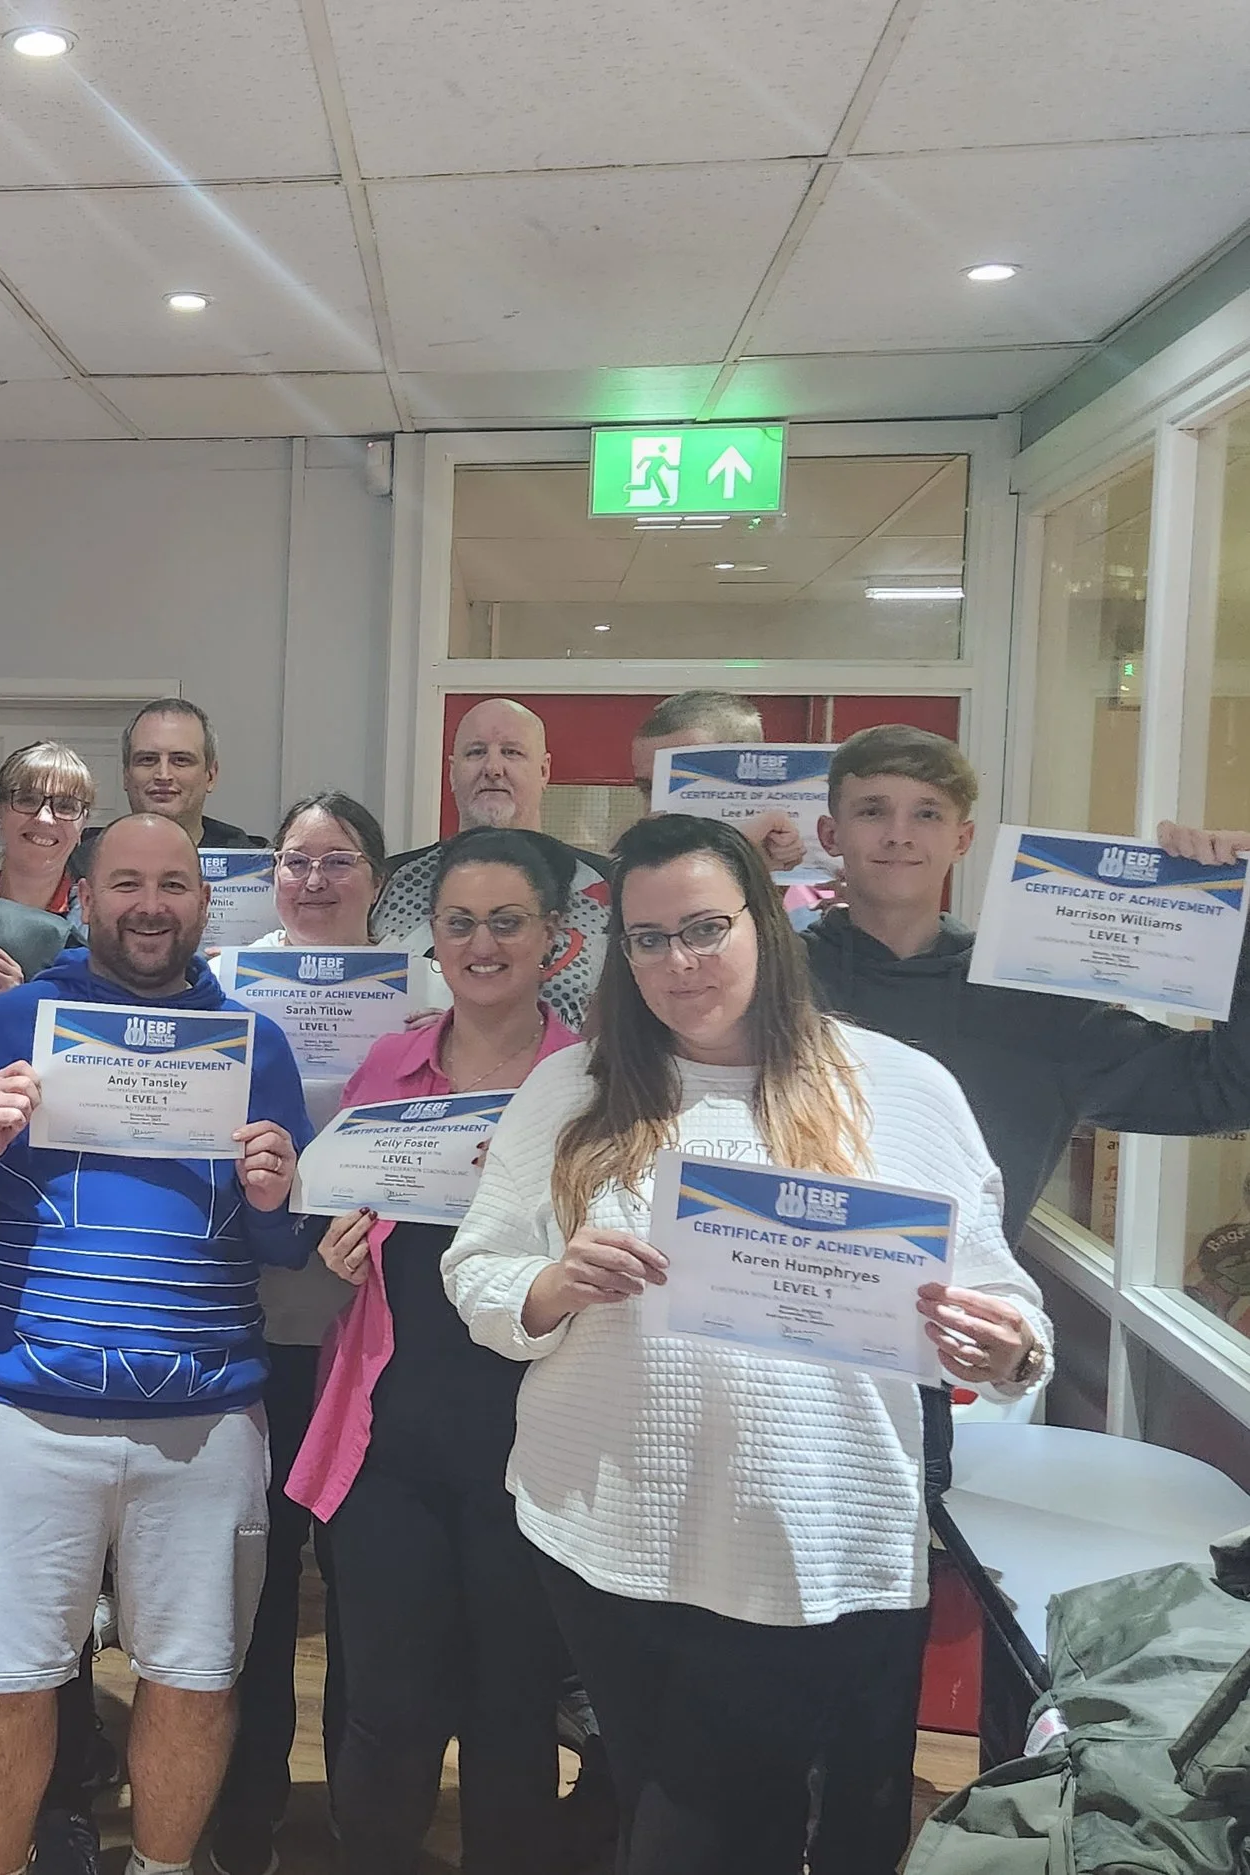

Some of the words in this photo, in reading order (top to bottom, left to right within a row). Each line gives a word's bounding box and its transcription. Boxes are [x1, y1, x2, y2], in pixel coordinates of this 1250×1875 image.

[760, 755, 789, 767] EBF
[680, 791, 747, 800] CERTIFICATE
[751, 792, 763, 800] OF
[766, 792, 828, 801] ACHIEVEME
[721, 808, 741, 818] Lee
[205, 857, 227, 867] EBF
[1125, 851, 1162, 868] EBF
[212, 885, 270, 893] ACHIEVEMENT
[1025, 882, 1105, 902] CERTIFICATE
[1109, 891, 1125, 902] OF
[1128, 894, 1225, 917] ACHIEVEMENT
[1055, 905, 1116, 923] Harrison
[1120, 914, 1183, 932] Williams
[1088, 929, 1129, 945] LEVEL
[1133, 935, 1141, 945] 1
[318, 957, 345, 968] EBF
[246, 989, 307, 998] CERTIFICATE
[310, 990, 323, 998] OF
[325, 990, 396, 1000] ACHIEVEMENT
[285, 1005, 317, 1015] Sarah
[147, 1020, 177, 1034] EBF
[299, 1022, 330, 1031] LEVEL
[332, 1023, 338, 1032] 1
[65, 1054, 135, 1068] CERTIFICATE
[137, 1058, 151, 1068] OF
[154, 1060, 233, 1071] ACHIEVEMENT
[107, 1075, 138, 1088] Andy
[141, 1077, 188, 1090] Tansley
[125, 1094, 158, 1104] LEVEL
[162, 1096, 168, 1104] 1
[341, 1127, 400, 1136] CERTIFICATE
[402, 1125, 418, 1133] OF
[419, 1124, 489, 1133] ACHIEVEMENT
[374, 1139, 401, 1149] Kelly
[403, 1139, 440, 1149] Foster
[382, 1155, 413, 1165] LEVEL
[417, 1156, 423, 1165] 1
[807, 1187, 850, 1207] EBF
[693, 1220, 791, 1246] CERTIFICATE
[792, 1235, 812, 1248] OF
[816, 1239, 927, 1267] ACHIEVEMENT
[731, 1249, 780, 1269] Karen
[785, 1259, 881, 1285] Humphryes
[773, 1280, 819, 1298] LEVEL
[825, 1287, 834, 1299] 1
